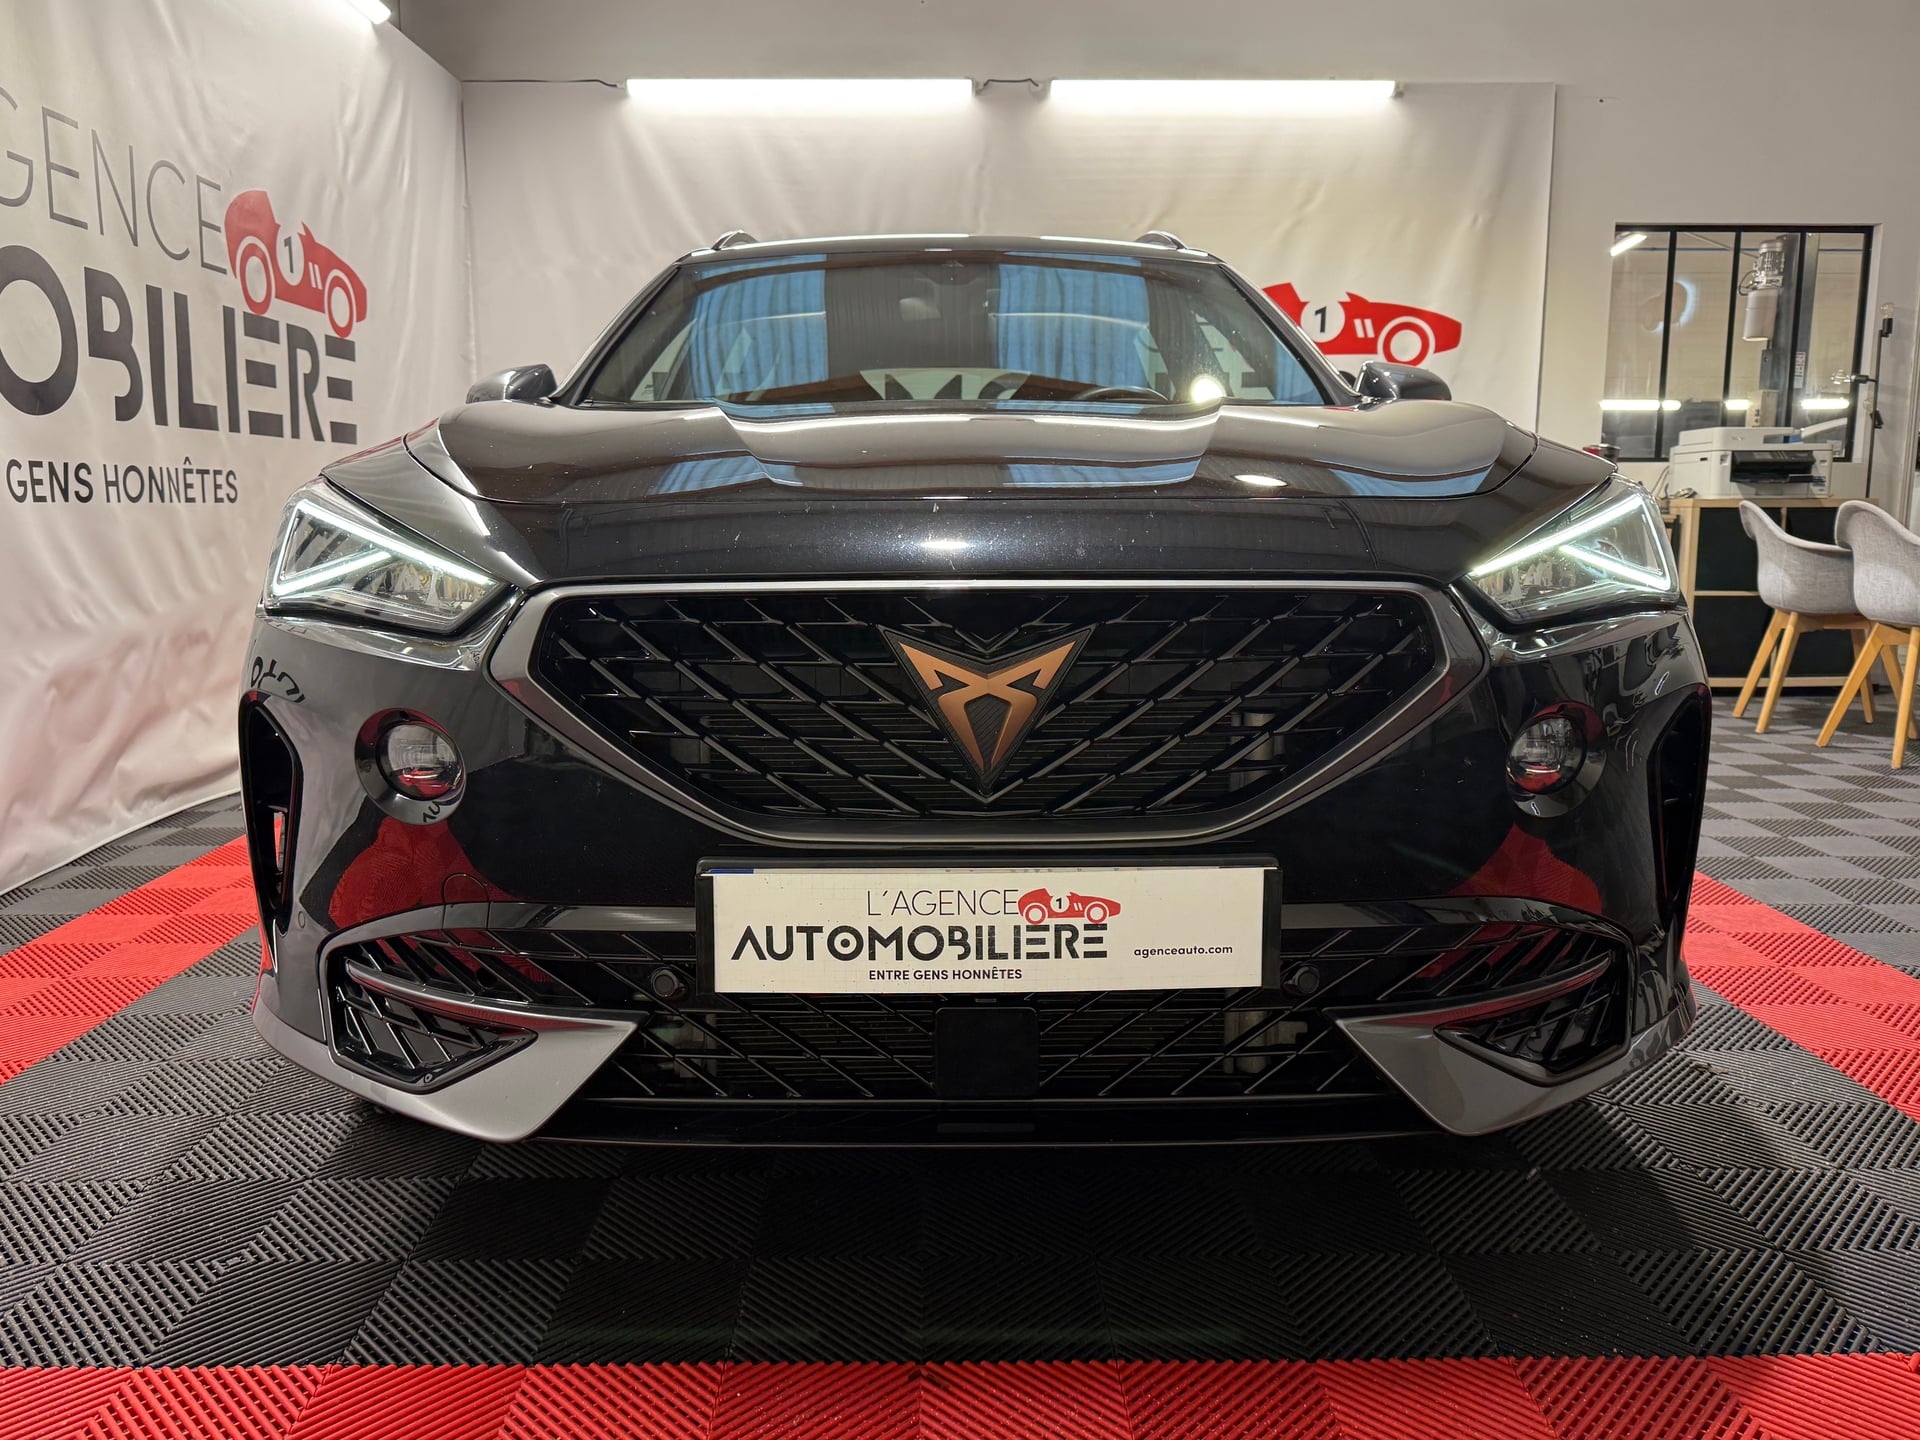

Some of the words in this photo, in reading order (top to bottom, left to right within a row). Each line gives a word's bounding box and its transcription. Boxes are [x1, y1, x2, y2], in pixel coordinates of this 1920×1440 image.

[283, 236, 294, 274] 1
[1314, 305, 1327, 334] 1
[6, 459, 94, 503] GENS
[103, 457, 239, 504] HONNÊTES
[867, 889, 1019, 916] L'AGENCE
[1055, 897, 1063, 910] 1
[731, 924, 1108, 961] AUTOMOBILIERE
[1133, 944, 1233, 959] agenceauto.com
[868, 969, 910, 981] ENTRE
[913, 969, 949, 981] GENS
[952, 966, 1023, 981] HONNÊTES
